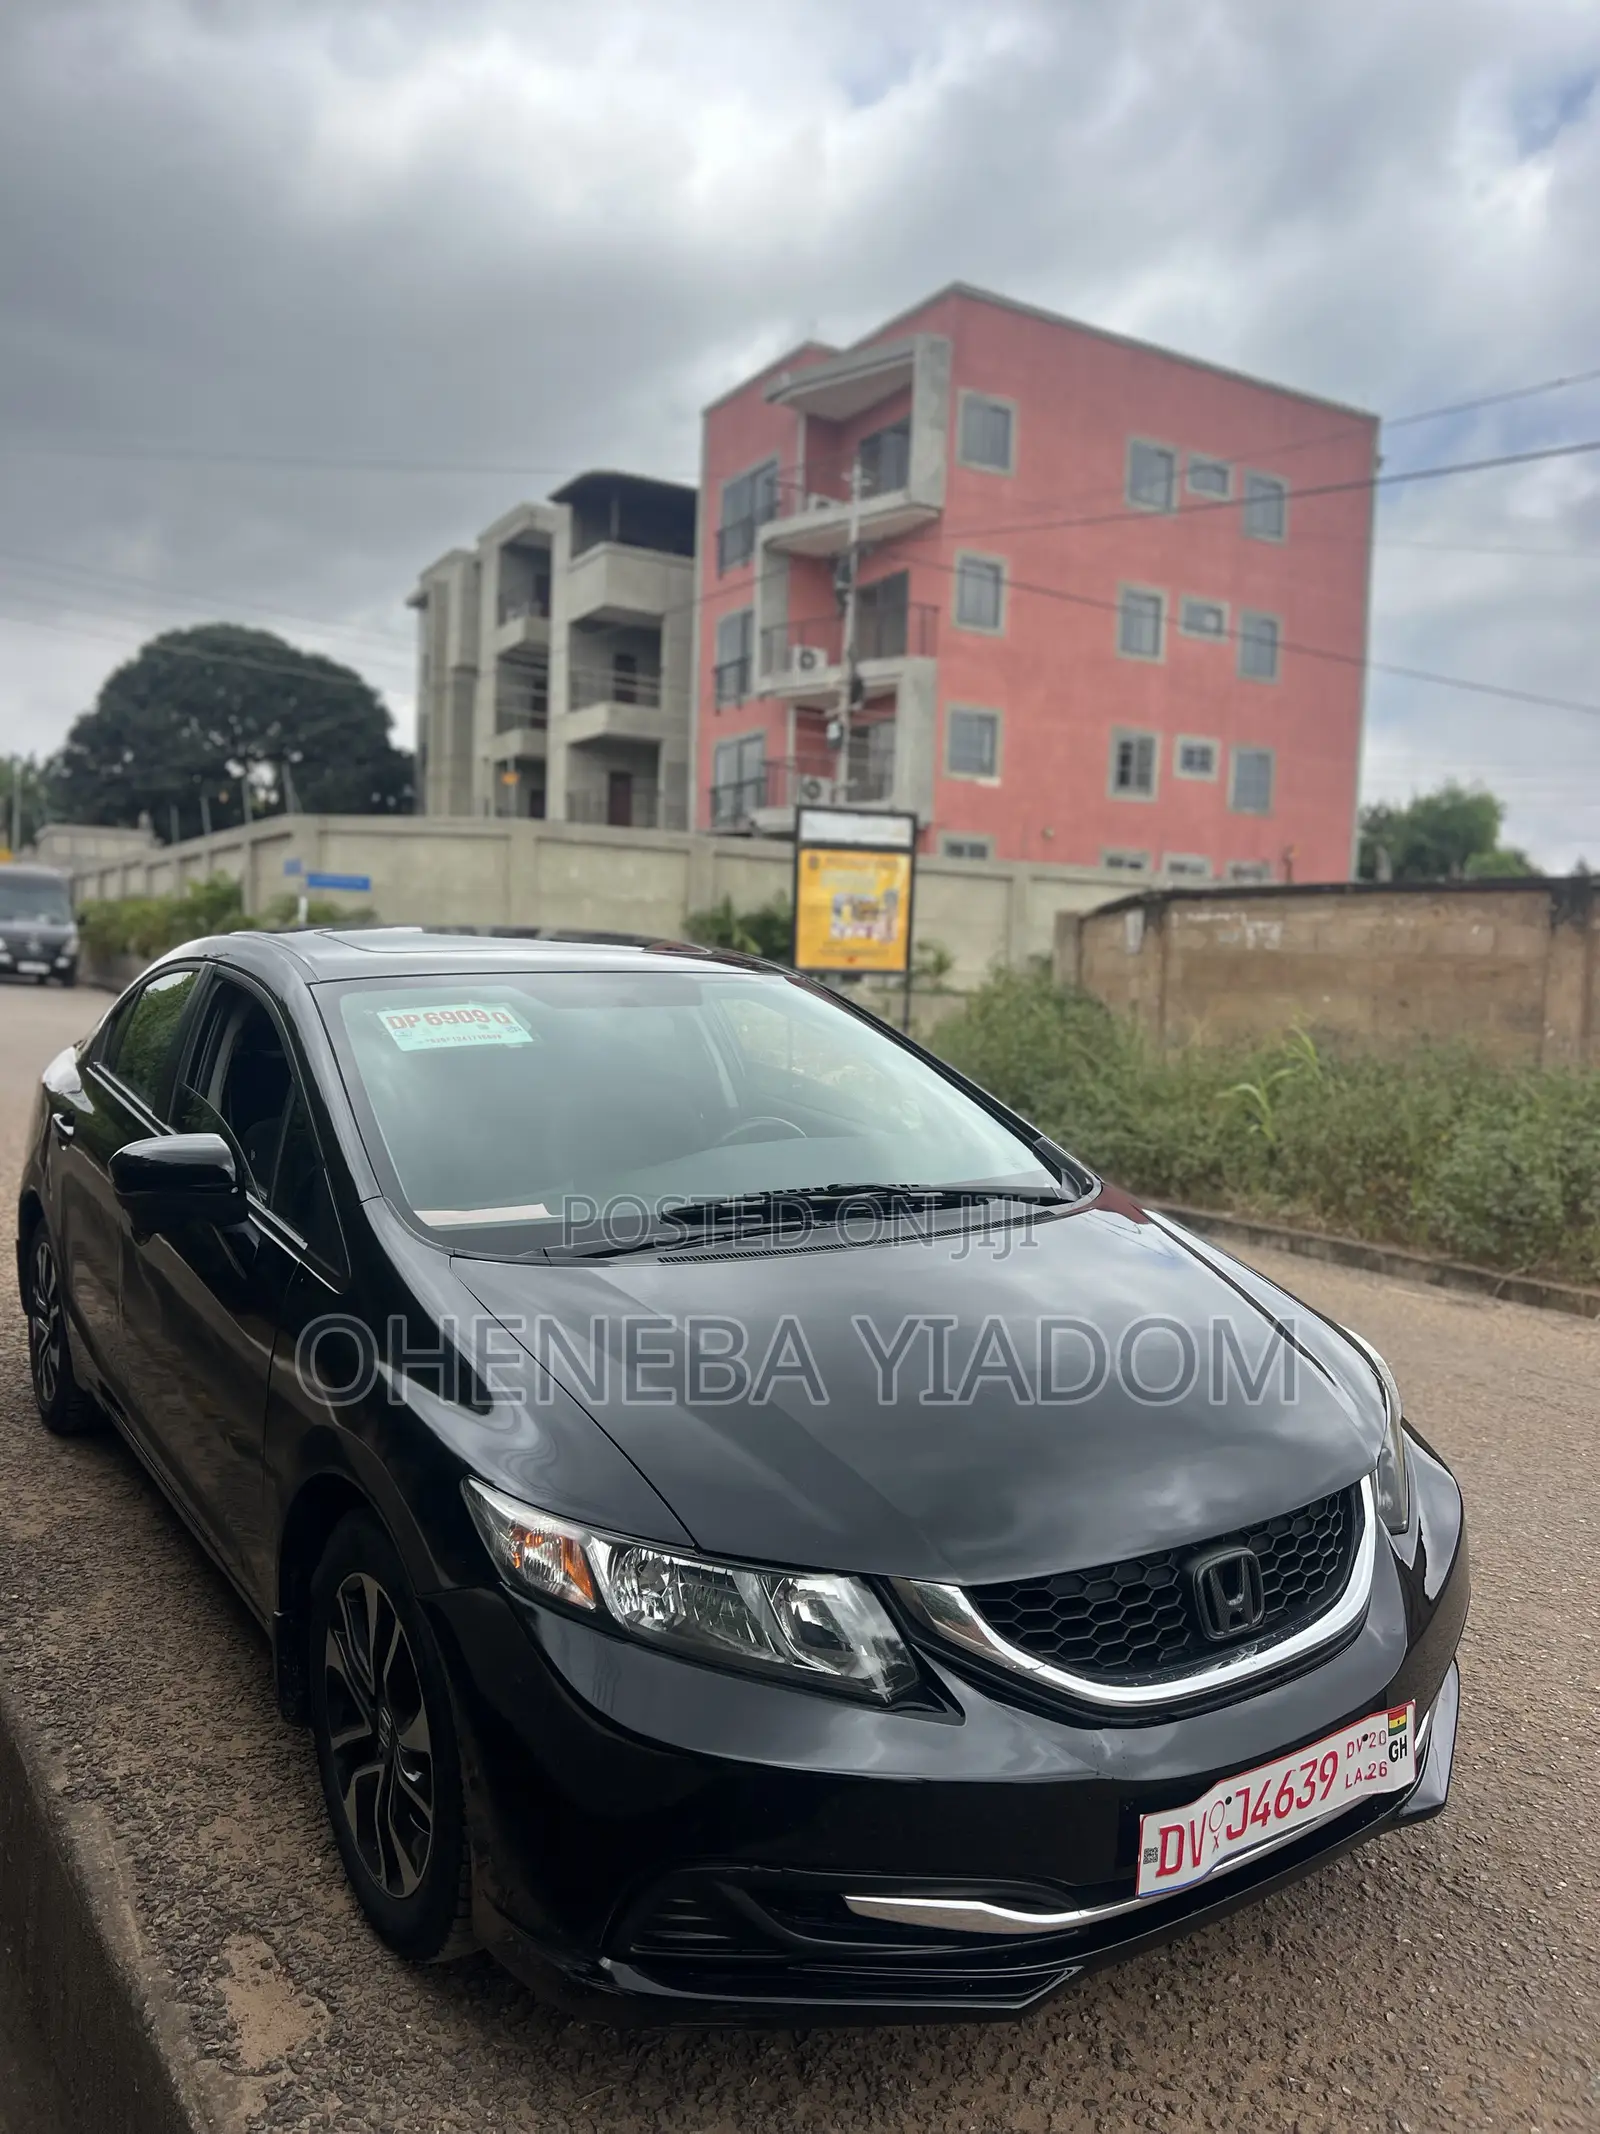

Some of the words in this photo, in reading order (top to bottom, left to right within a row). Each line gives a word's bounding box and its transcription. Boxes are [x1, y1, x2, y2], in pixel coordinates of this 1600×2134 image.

[386, 1013, 421, 1029] DP
[423, 1009, 490, 1026] 6909
[1388, 1735, 1408, 1762] GH
[1155, 1811, 1207, 1878] DV
[1226, 1750, 1339, 1841] J4639
